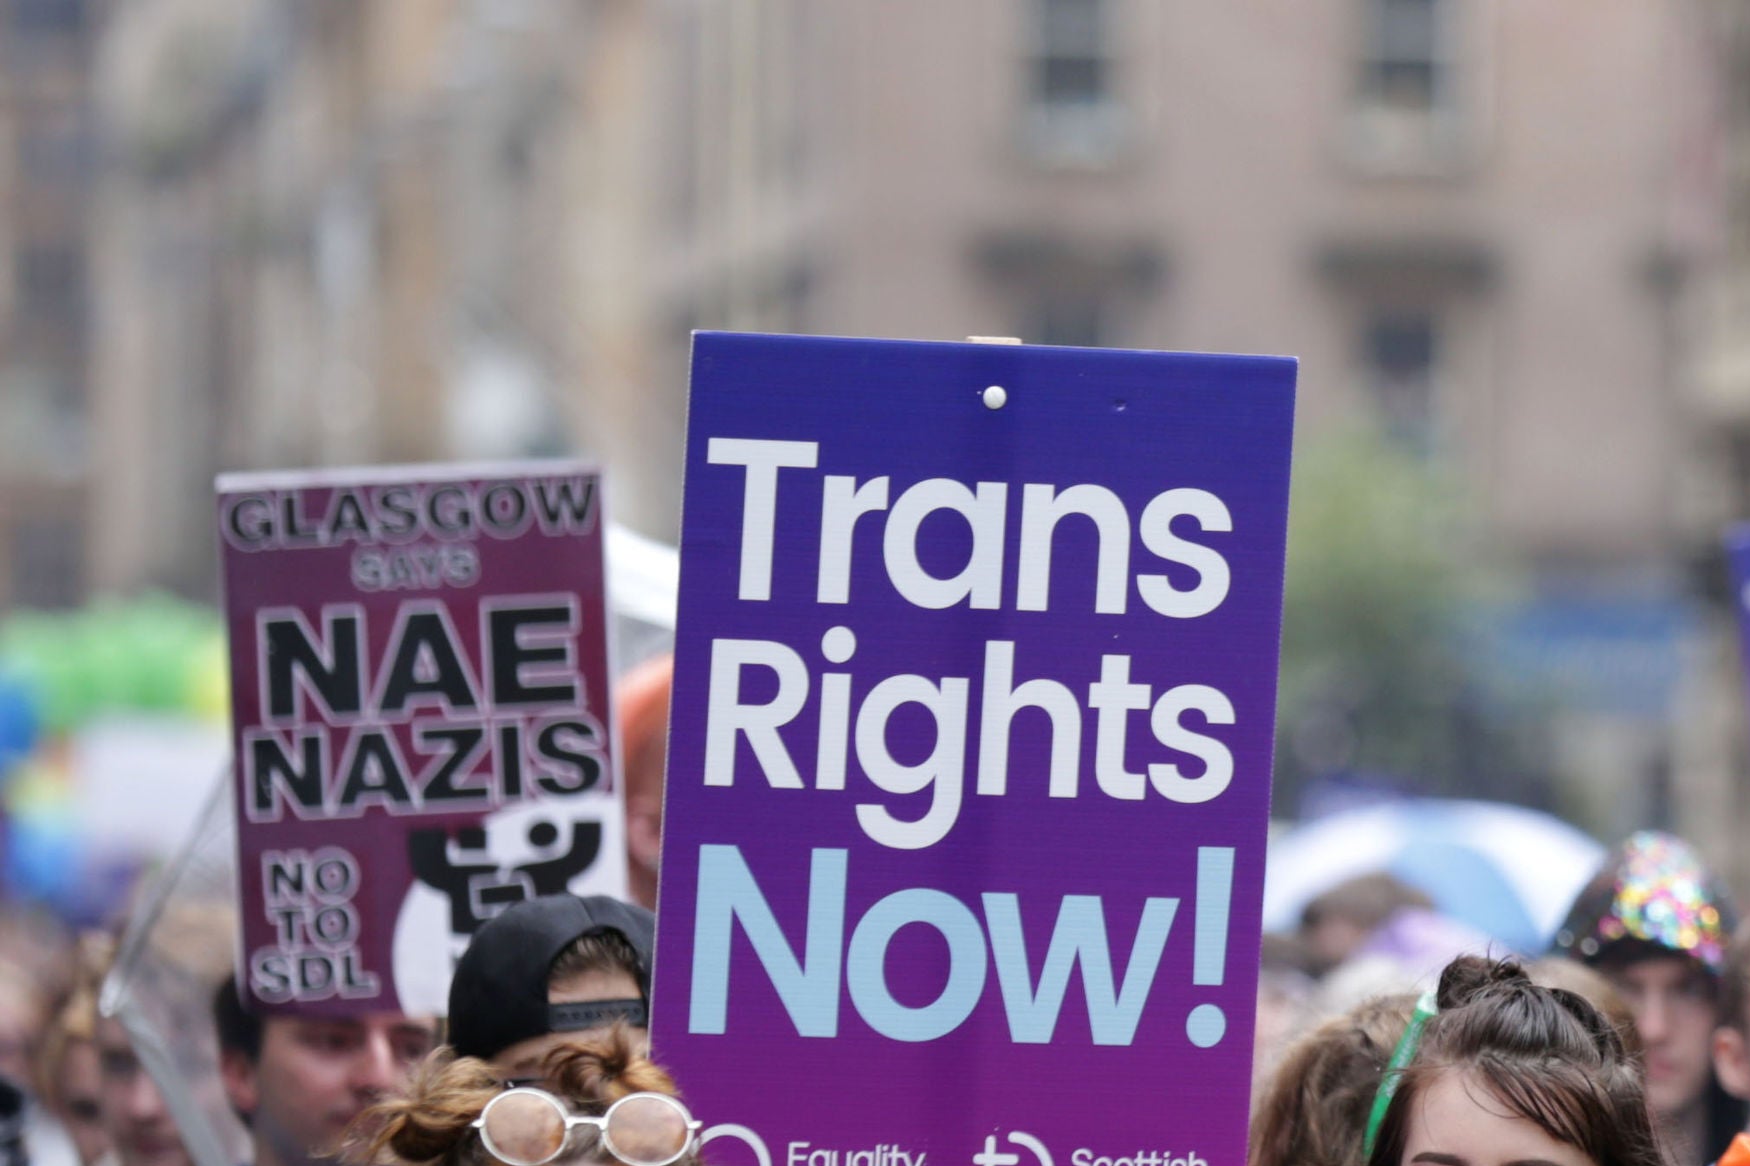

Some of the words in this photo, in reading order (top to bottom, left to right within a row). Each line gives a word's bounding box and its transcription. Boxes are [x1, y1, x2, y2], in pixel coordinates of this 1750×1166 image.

[228, 481, 596, 546] GLASGOW
[708, 438, 1232, 618] Trans
[264, 602, 580, 720] NAE
[248, 718, 604, 815] NAZIS
[704, 626, 1235, 849] Rights
[266, 850, 358, 902] NO
[277, 905, 358, 948] TO
[688, 844, 1235, 1048] Now!
[254, 953, 376, 1000] SDL
